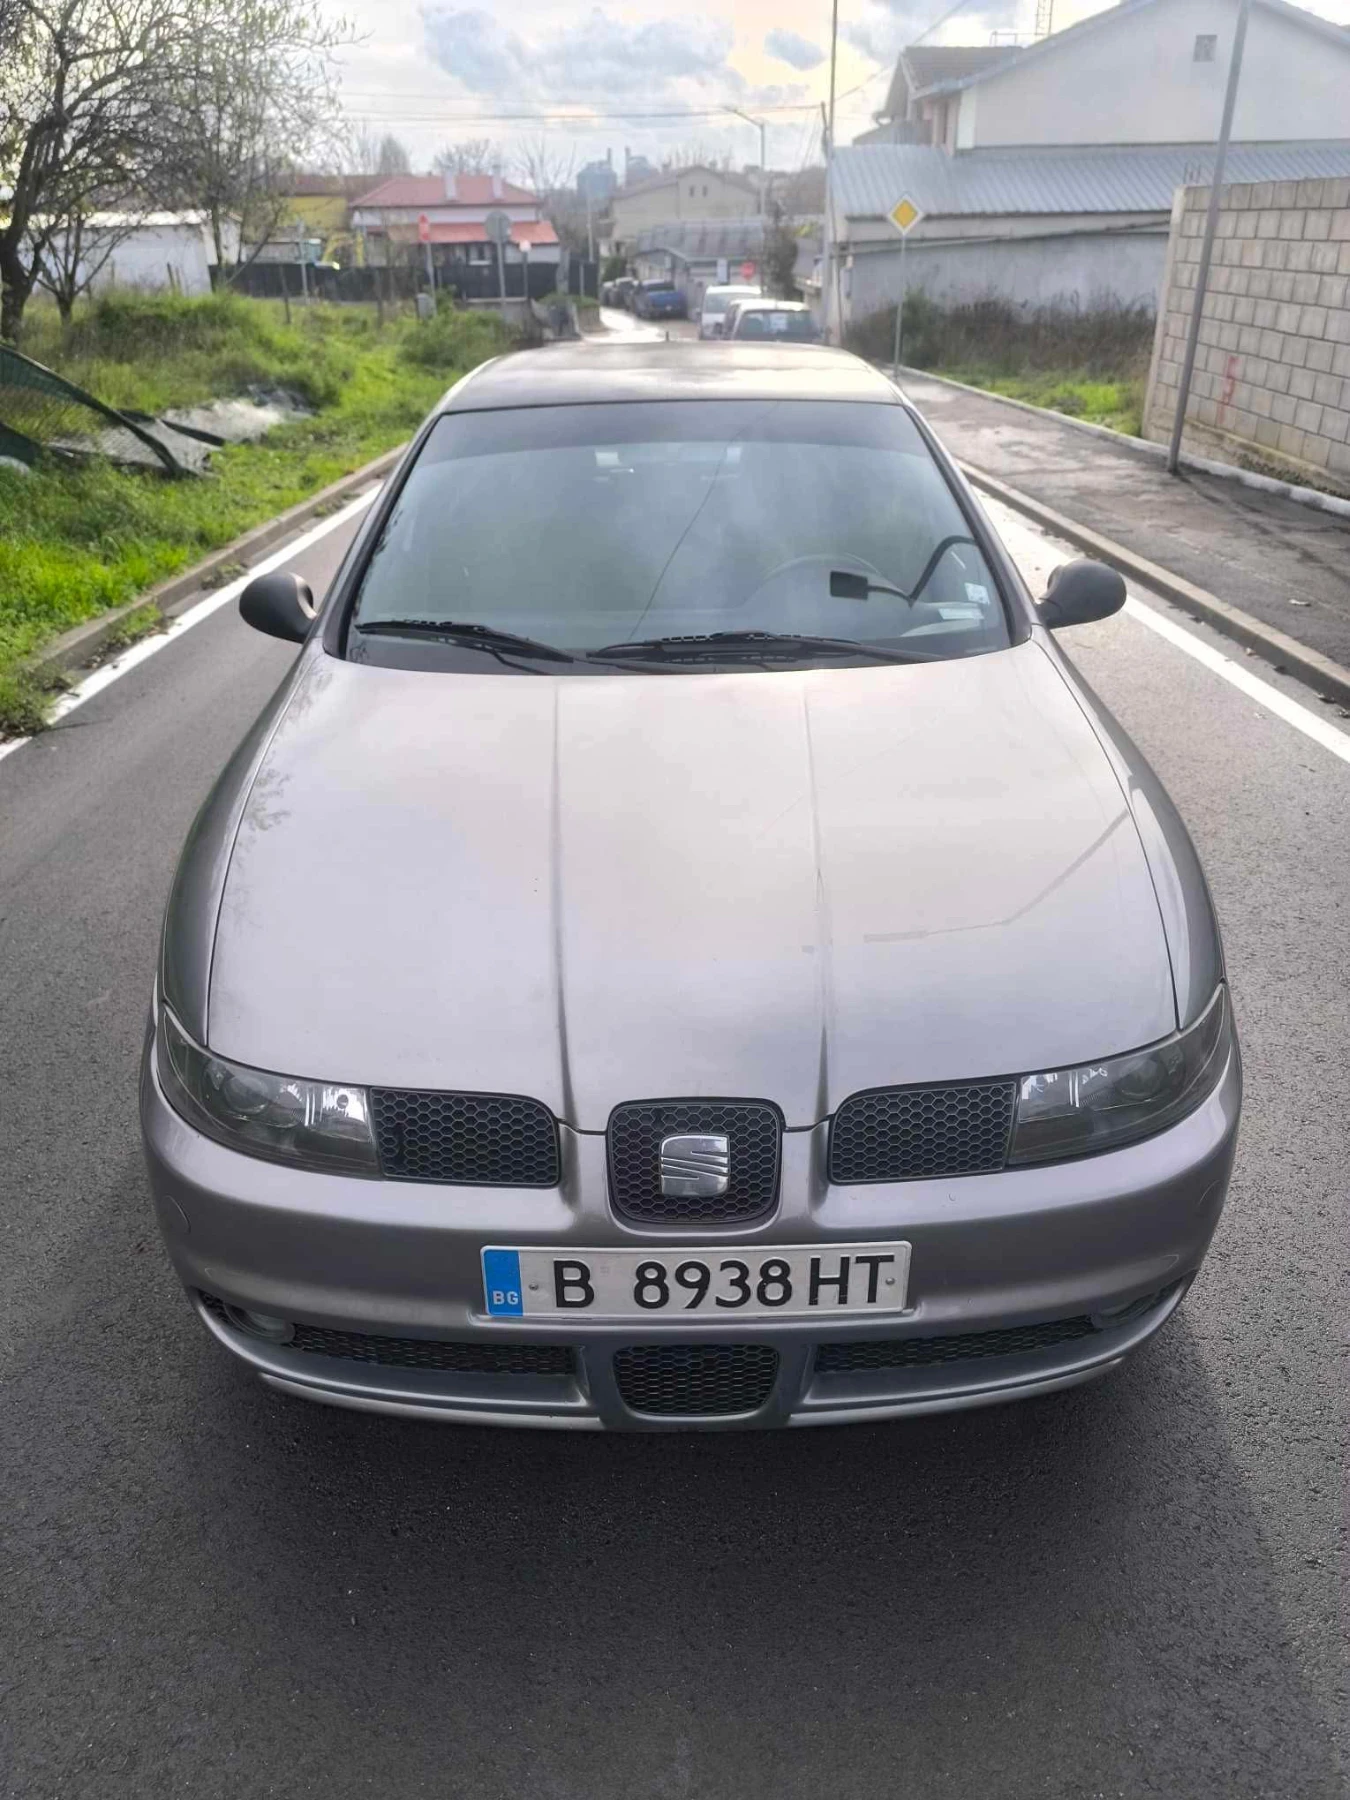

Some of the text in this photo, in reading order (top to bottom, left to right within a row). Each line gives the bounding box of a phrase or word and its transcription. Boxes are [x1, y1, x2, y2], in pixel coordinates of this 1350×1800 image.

[492, 1290, 519, 1305] BG
[553, 1254, 895, 1309] B 8938 HT
